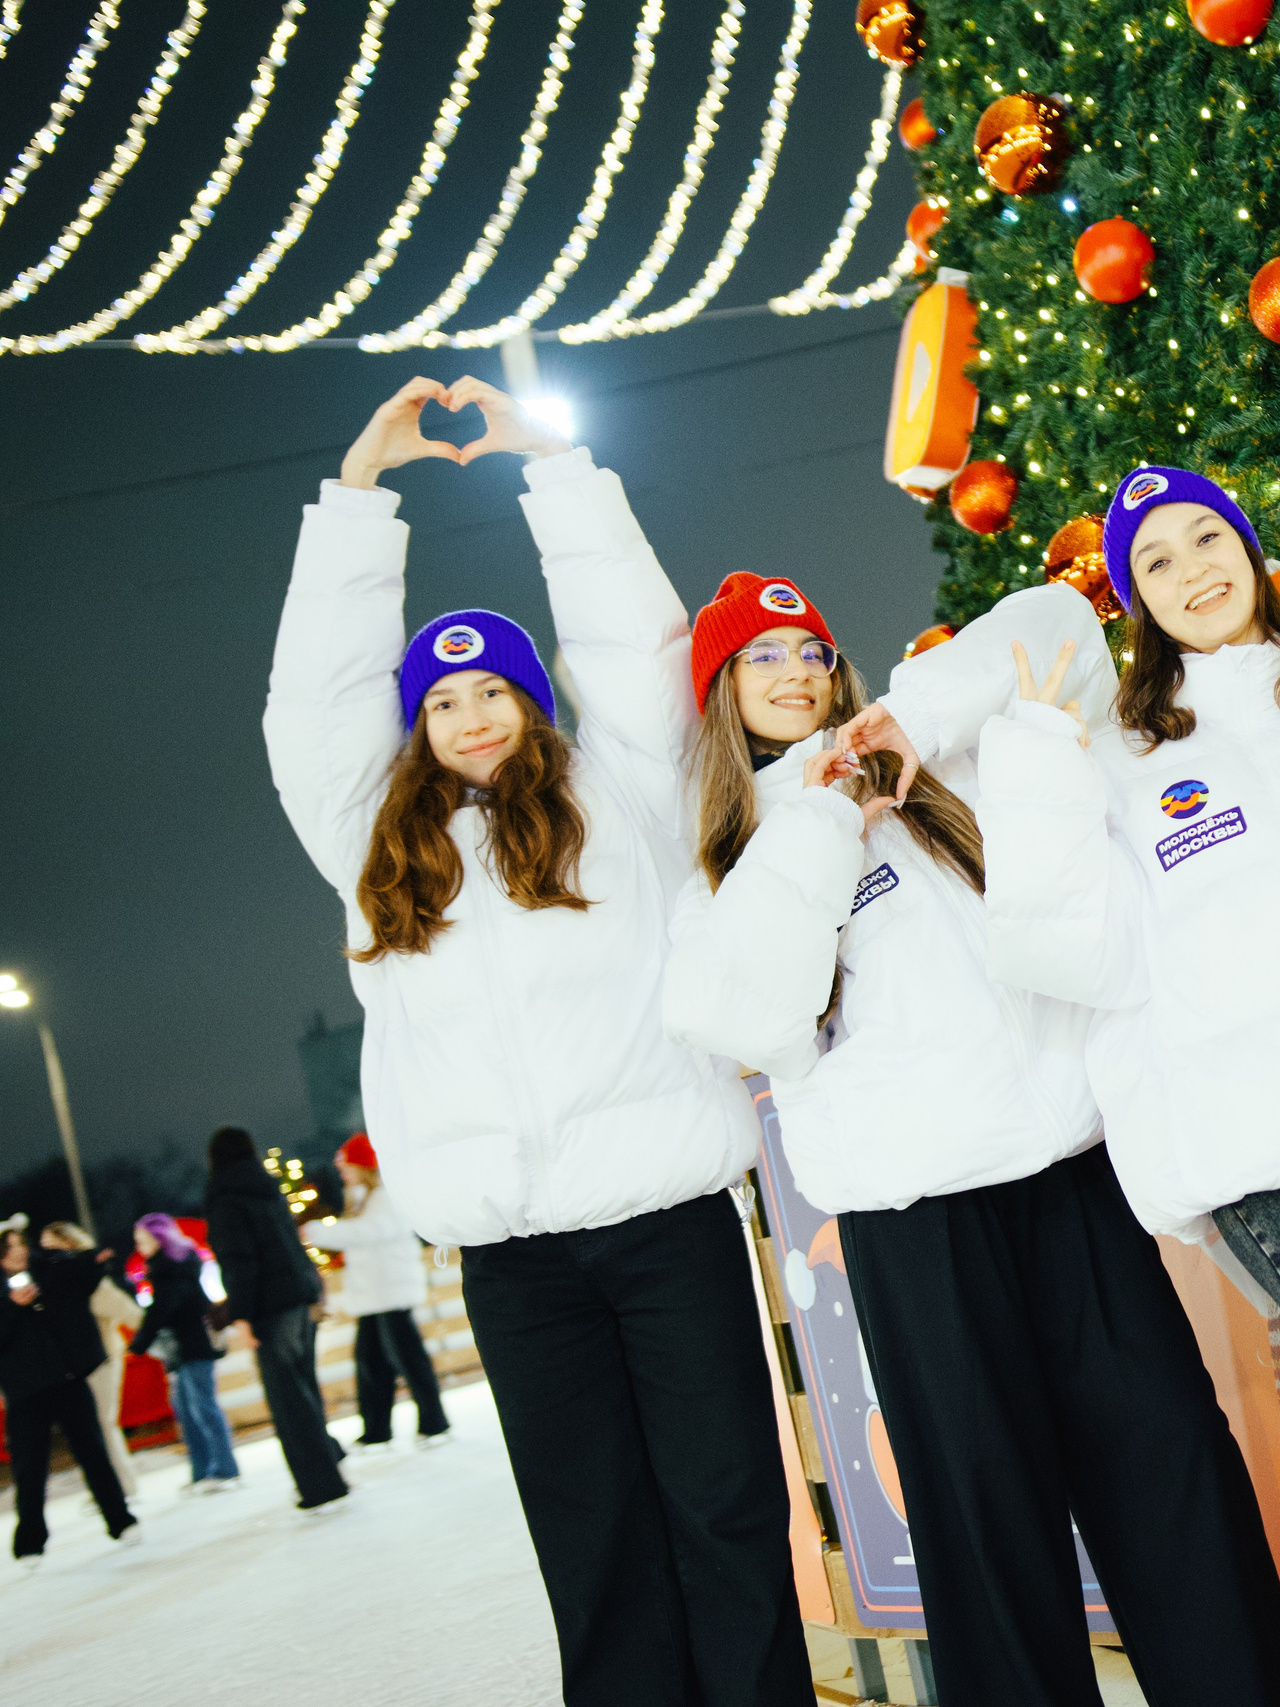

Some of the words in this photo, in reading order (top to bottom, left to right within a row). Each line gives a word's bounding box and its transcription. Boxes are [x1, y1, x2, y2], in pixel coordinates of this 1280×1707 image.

[1158, 811, 1239, 854] МОЛОДЁЖЬ
[1163, 820, 1244, 868] МОСКВЫ
[851, 875, 897, 910] СКВЫ
[855, 868, 889, 894] ДЁЖЬ
